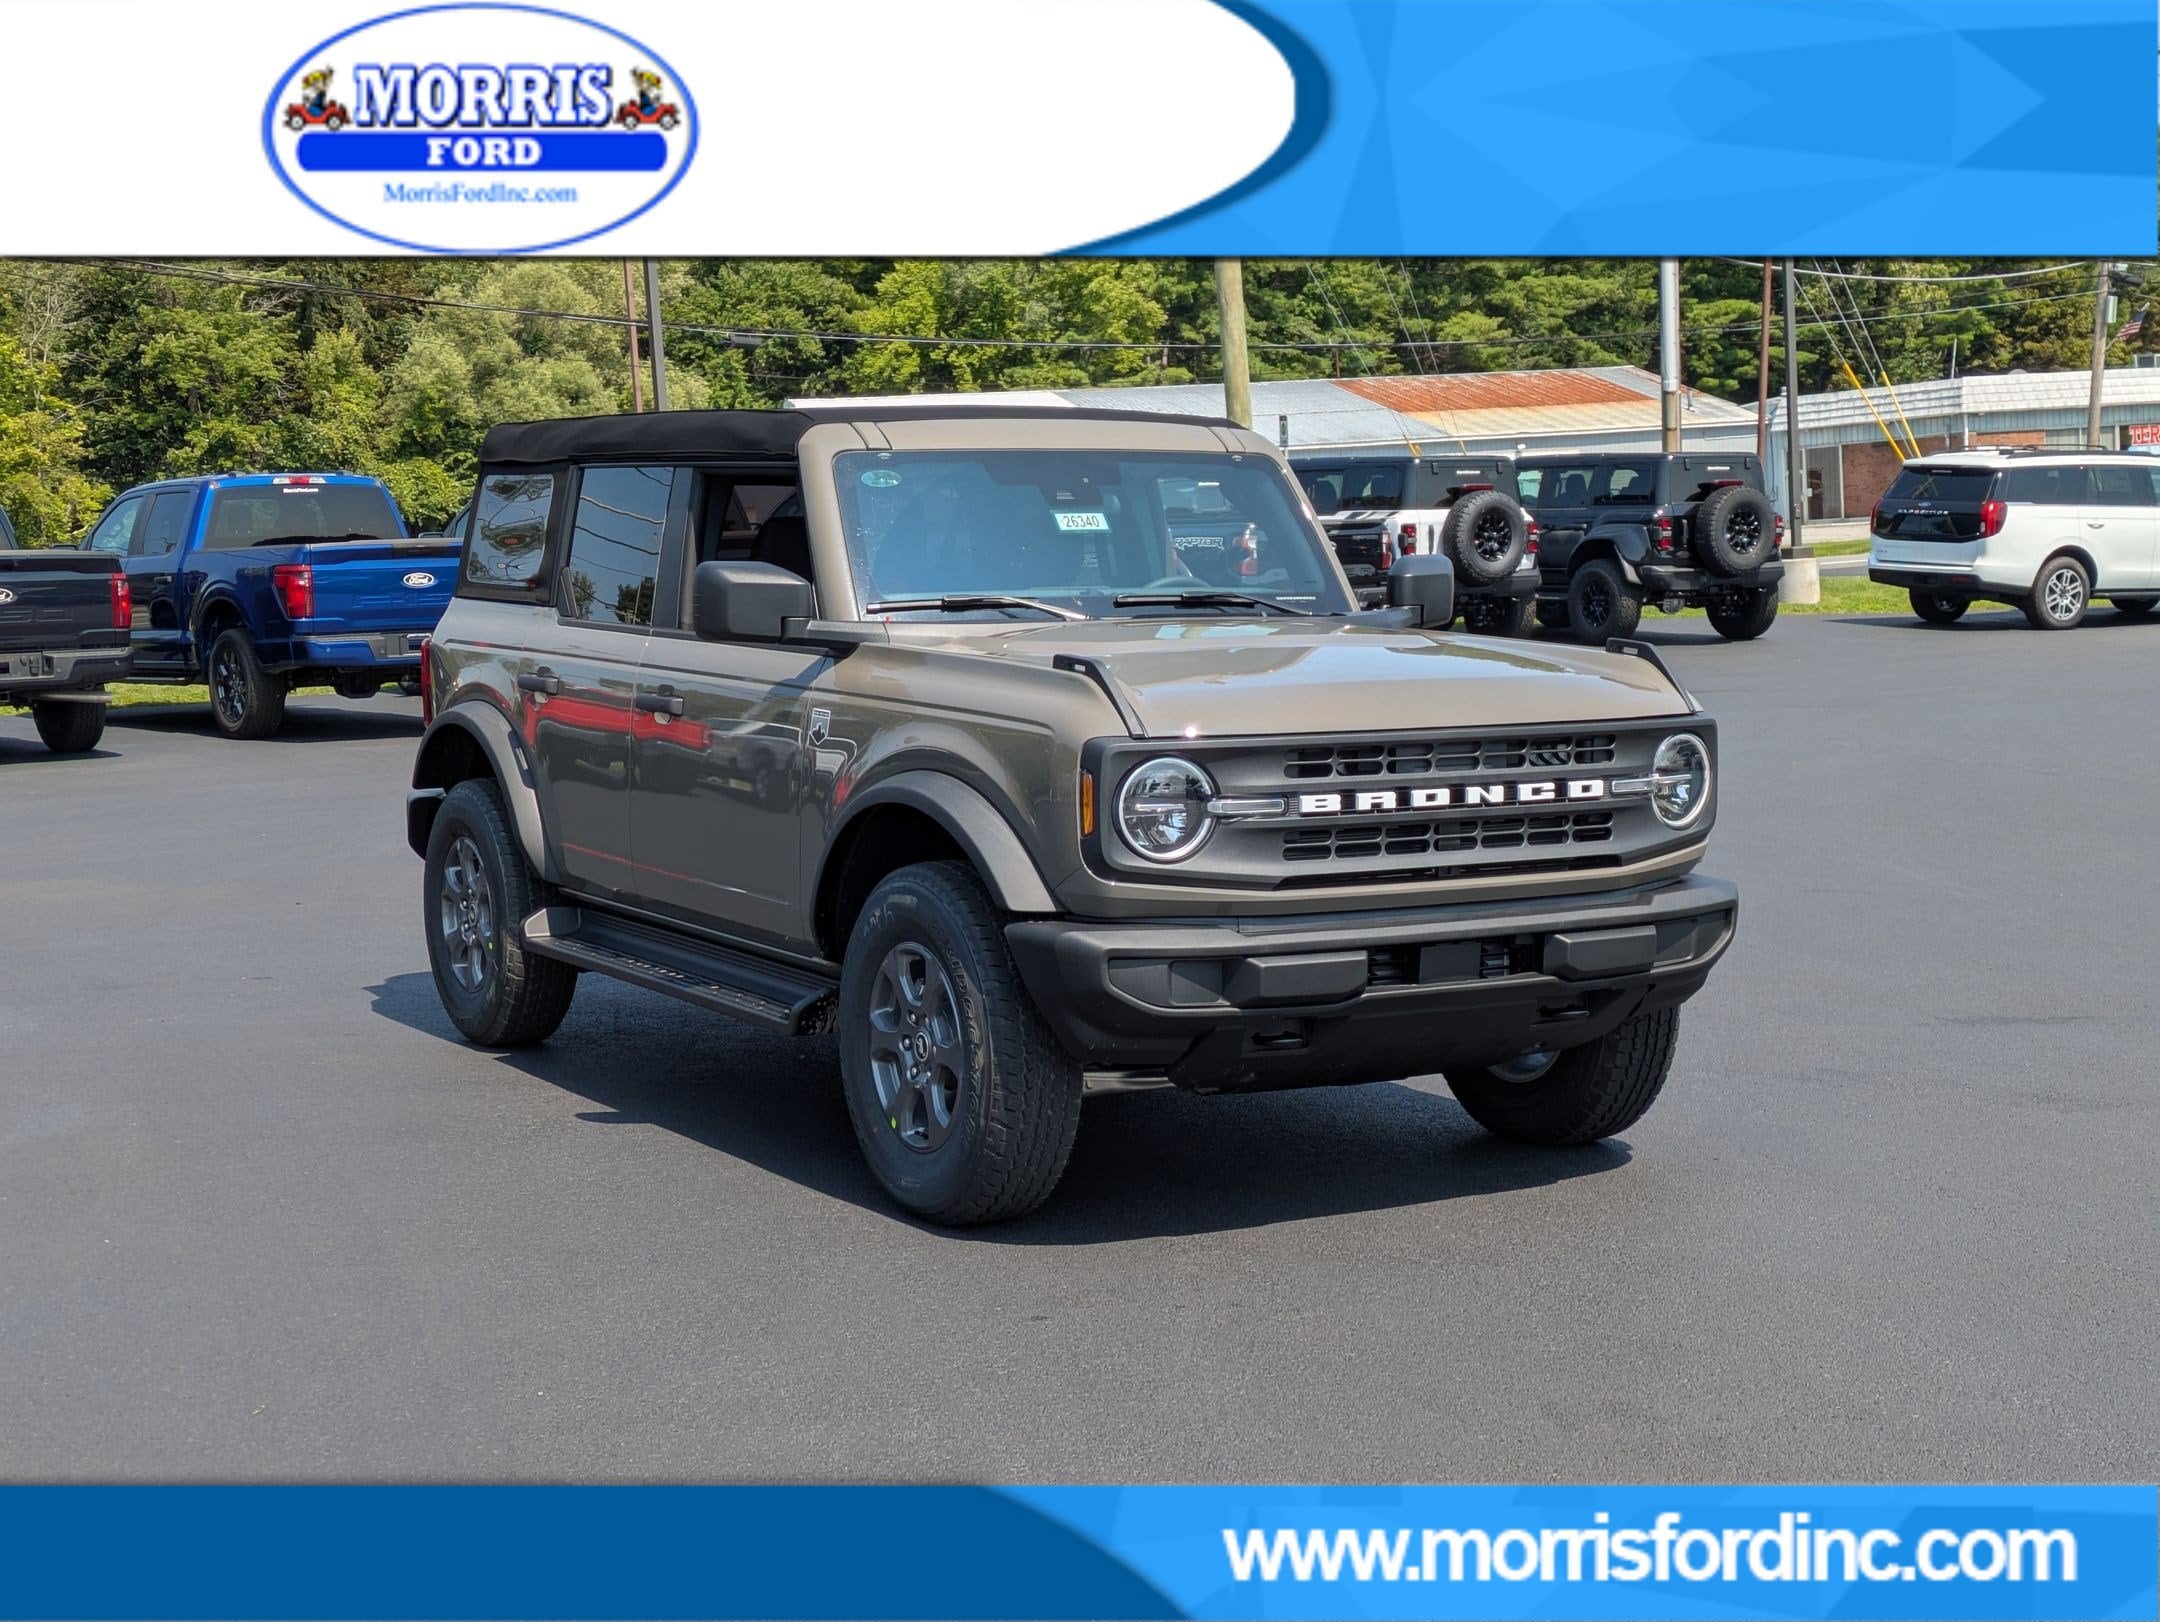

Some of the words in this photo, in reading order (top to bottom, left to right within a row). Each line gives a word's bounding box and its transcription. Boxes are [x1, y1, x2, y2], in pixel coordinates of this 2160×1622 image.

[1062, 515, 1100, 528] 26340
[1175, 536, 1225, 551] RAPTOR
[1299, 779, 1604, 813] BRONCO
